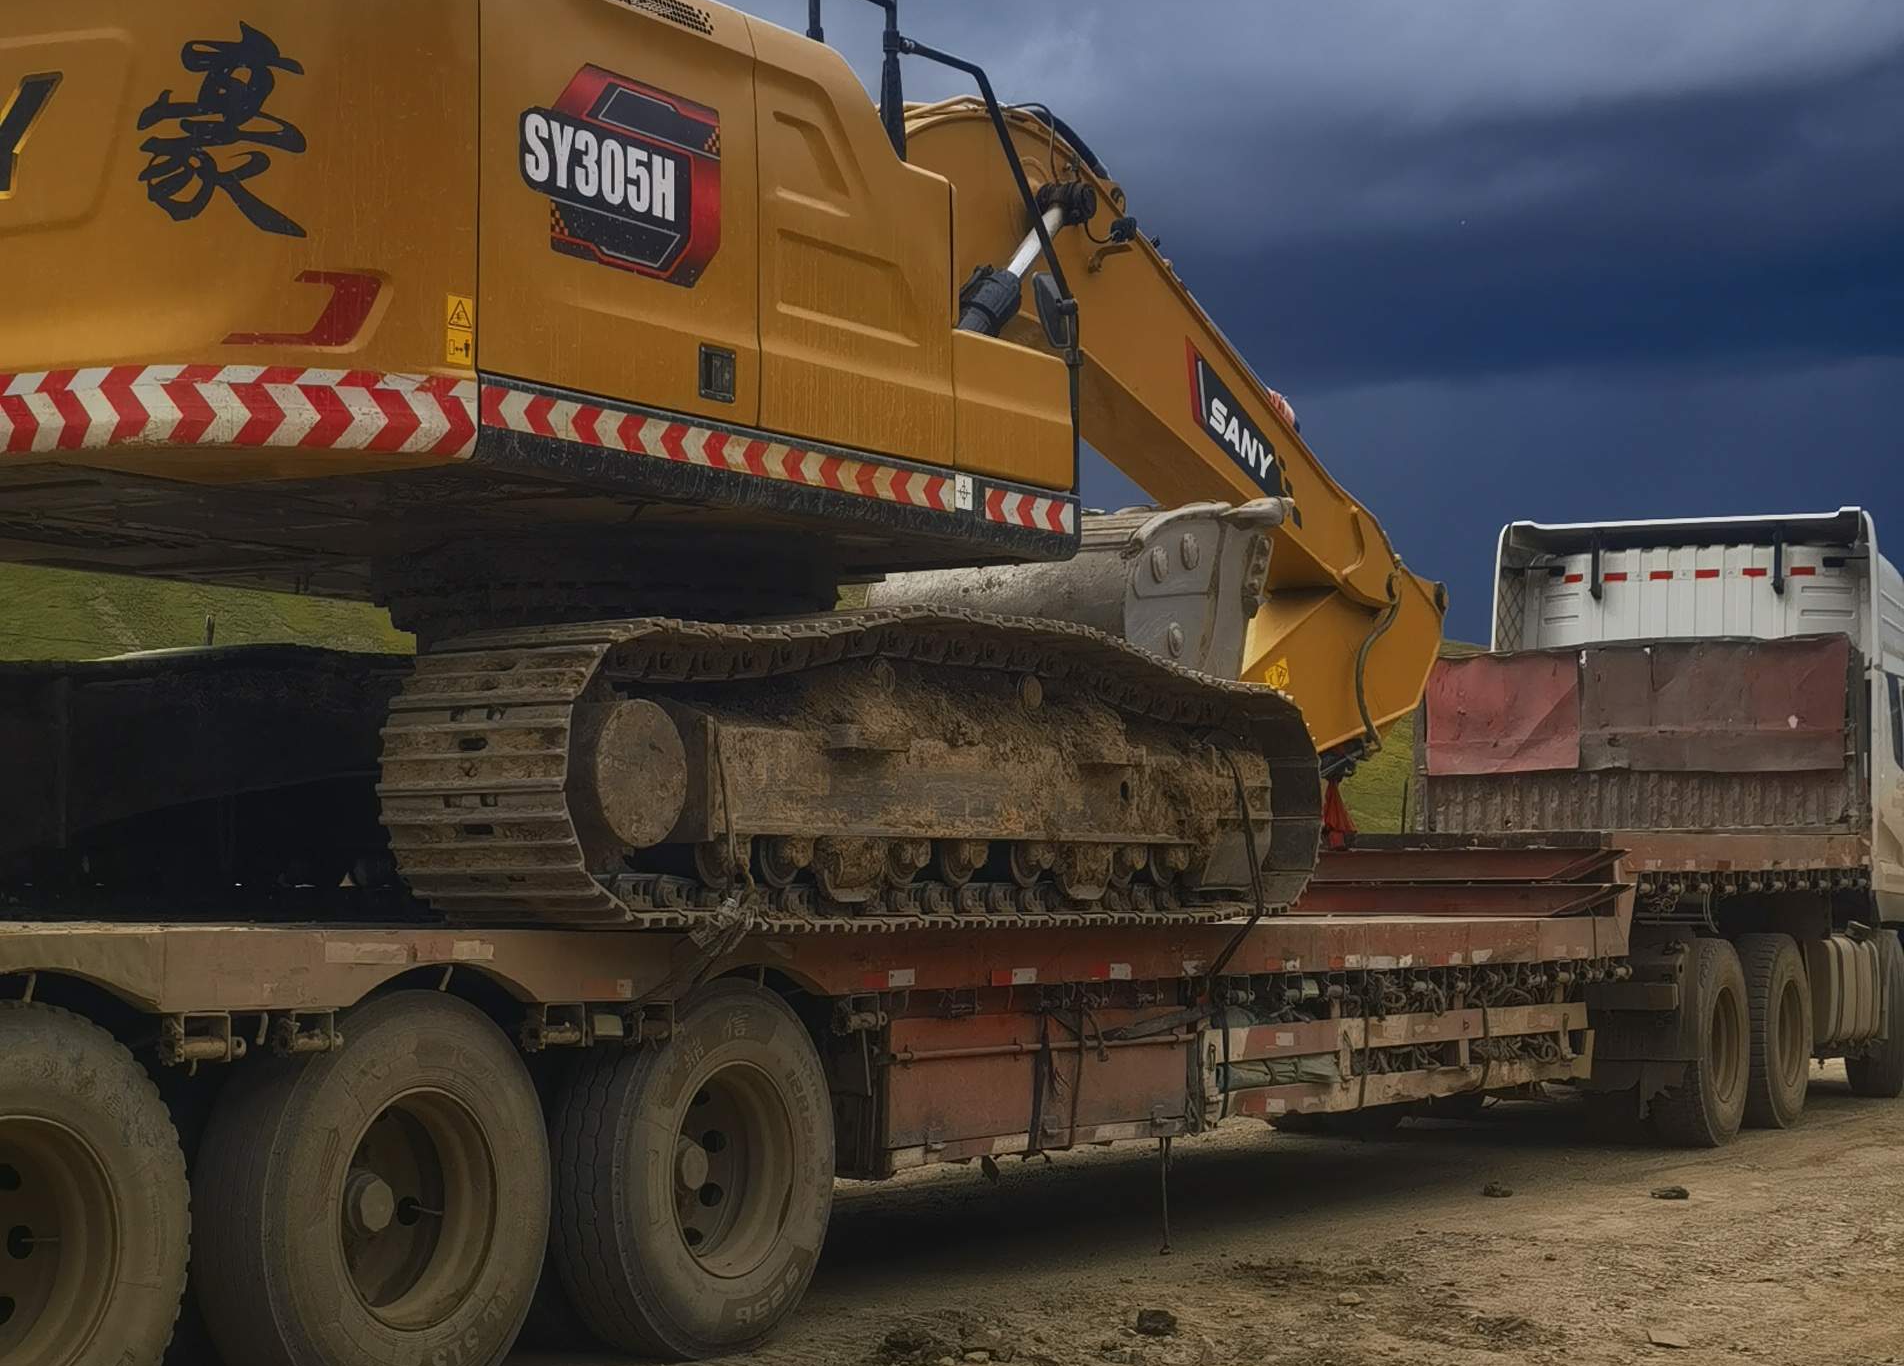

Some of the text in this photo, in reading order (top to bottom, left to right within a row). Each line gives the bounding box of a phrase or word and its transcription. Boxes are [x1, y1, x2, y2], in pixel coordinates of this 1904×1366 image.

[138, 22, 307, 237] 豪
[525, 113, 675, 221] SY305H
[1209, 397, 1274, 478] SANY
